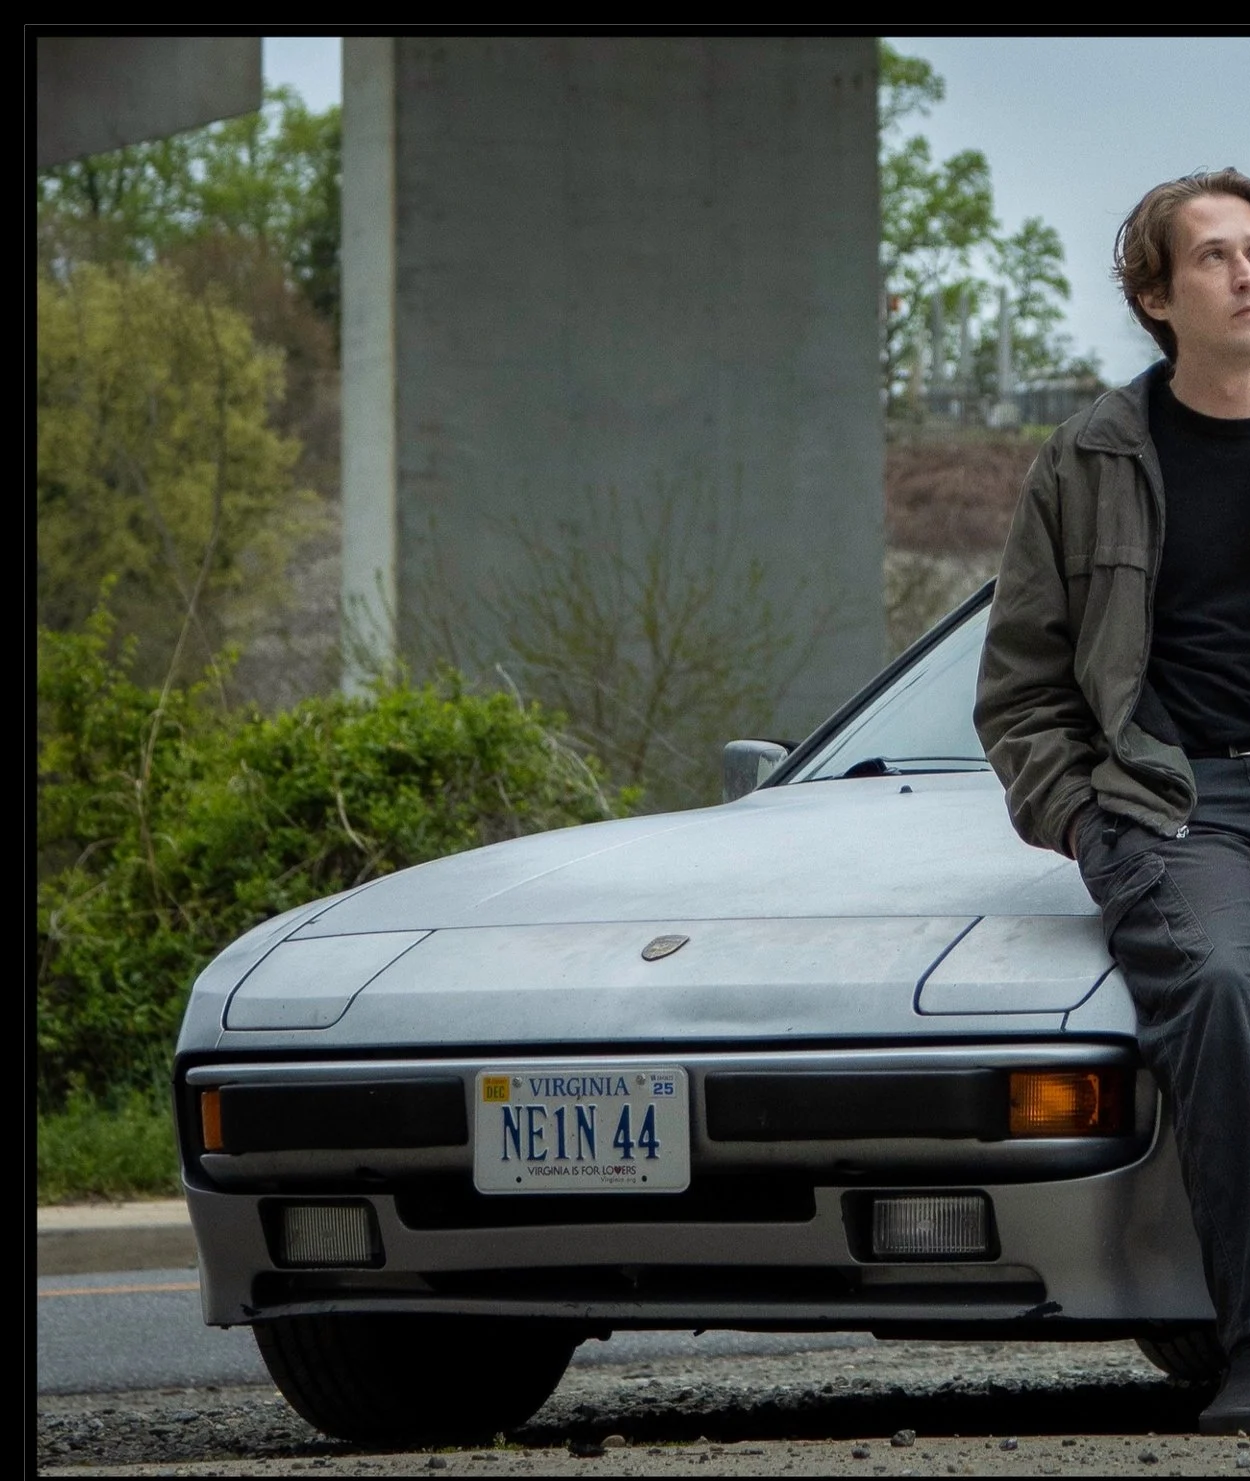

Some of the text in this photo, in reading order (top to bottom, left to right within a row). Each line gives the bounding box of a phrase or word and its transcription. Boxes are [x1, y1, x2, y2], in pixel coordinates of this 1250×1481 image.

[486, 1086, 505, 1099] DEC
[529, 1077, 630, 1097] VIRGINIA
[653, 1082, 674, 1095] 25
[501, 1103, 660, 1161] NE1N 44
[527, 1166, 570, 1176] VIRGINIA
[571, 1166, 579, 1175] IS
[581, 1165, 600, 1175] FOR
